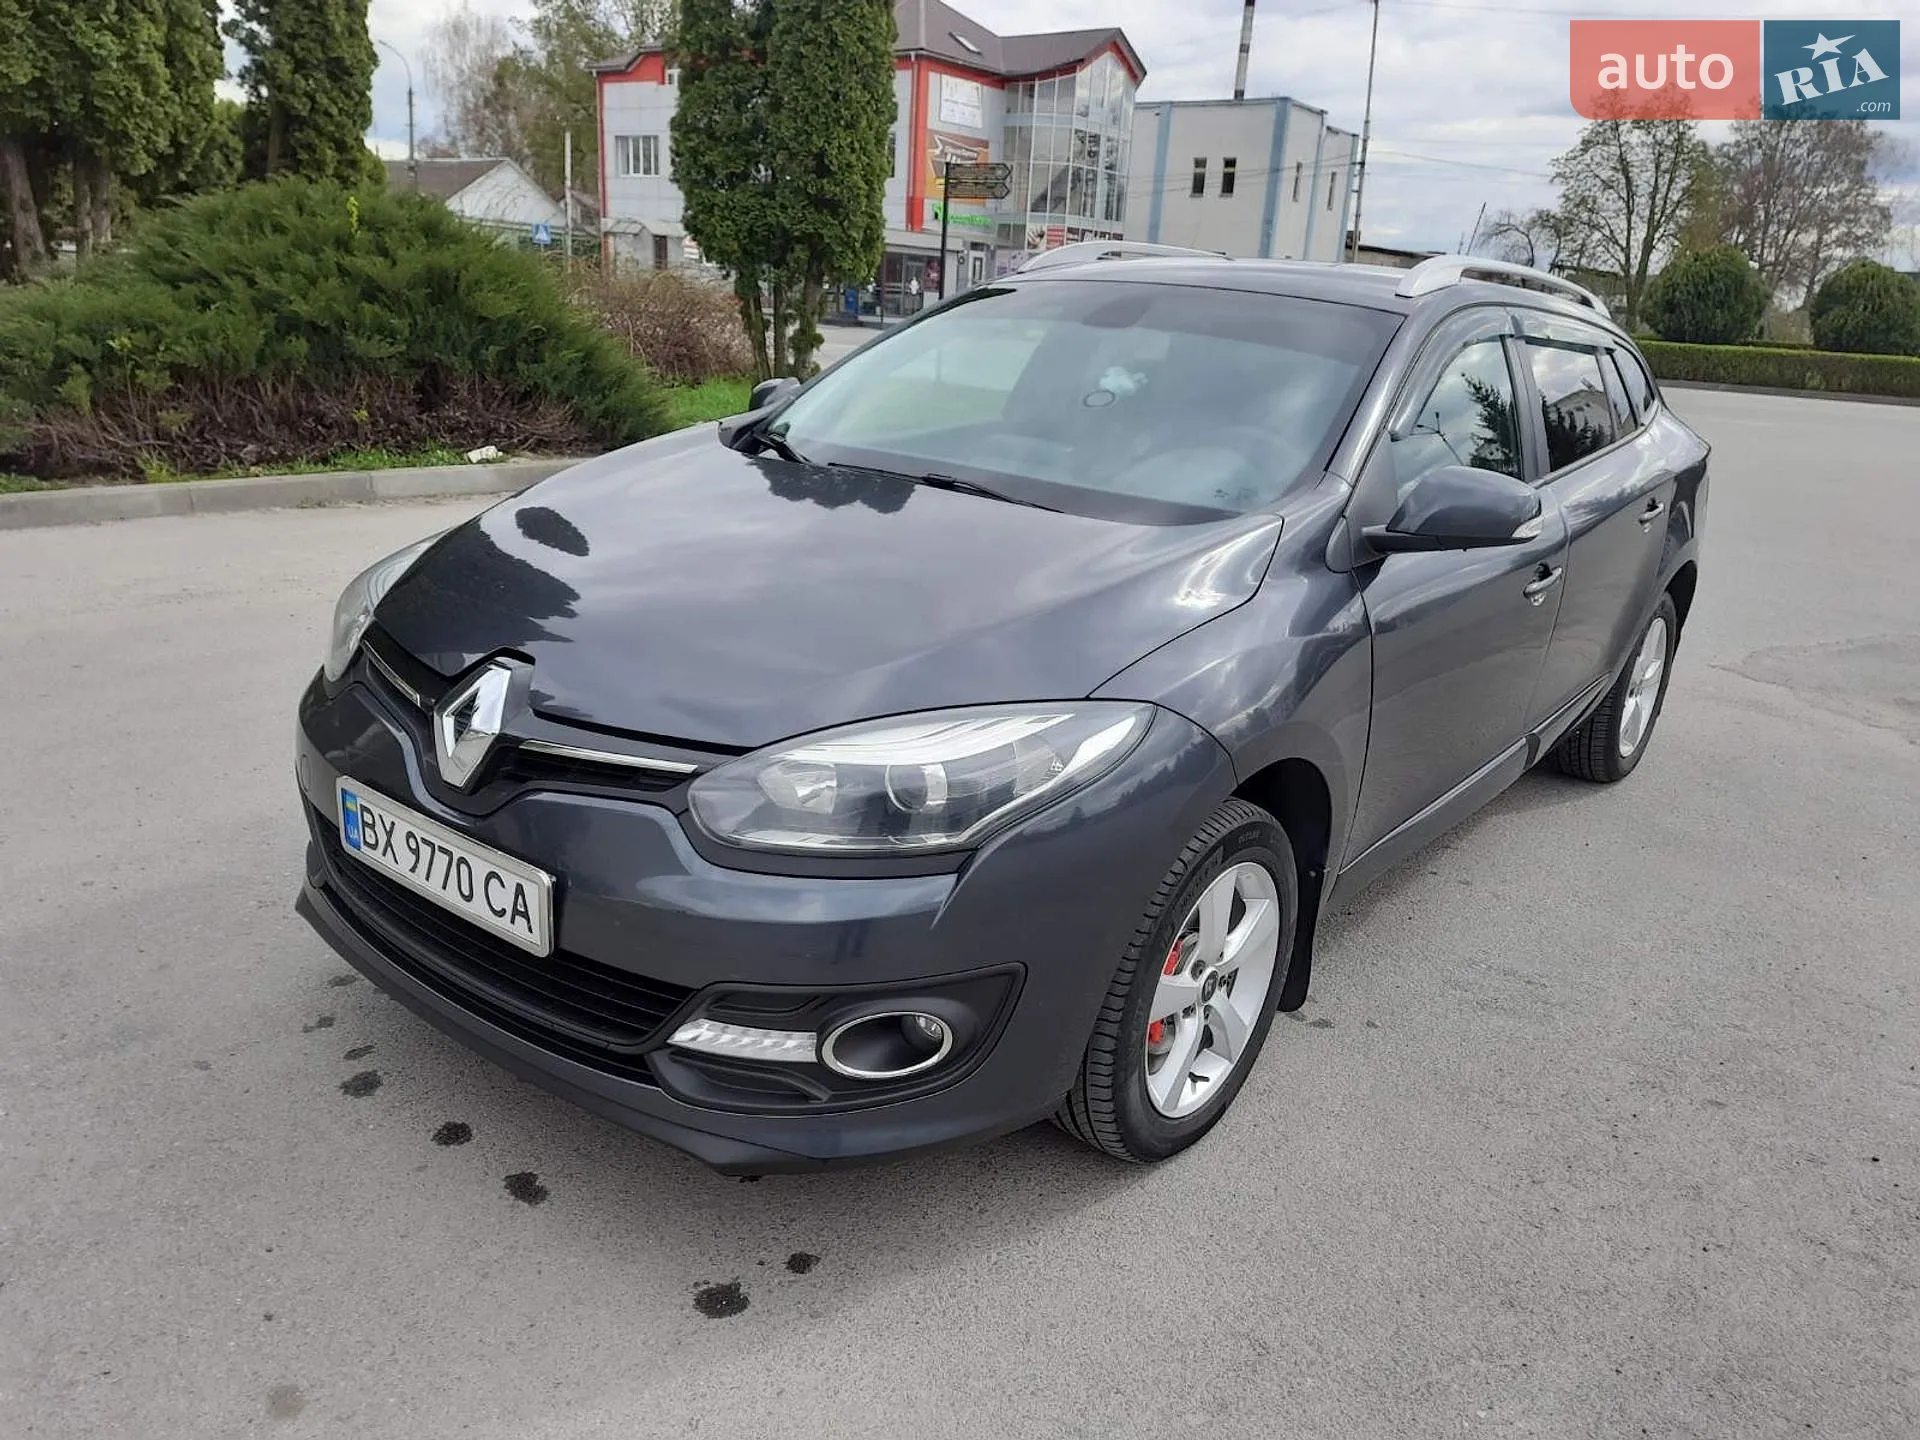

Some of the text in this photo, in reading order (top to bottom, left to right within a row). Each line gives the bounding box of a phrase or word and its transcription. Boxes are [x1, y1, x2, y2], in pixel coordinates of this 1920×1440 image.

[360, 803, 533, 934] BX 9770 CA
